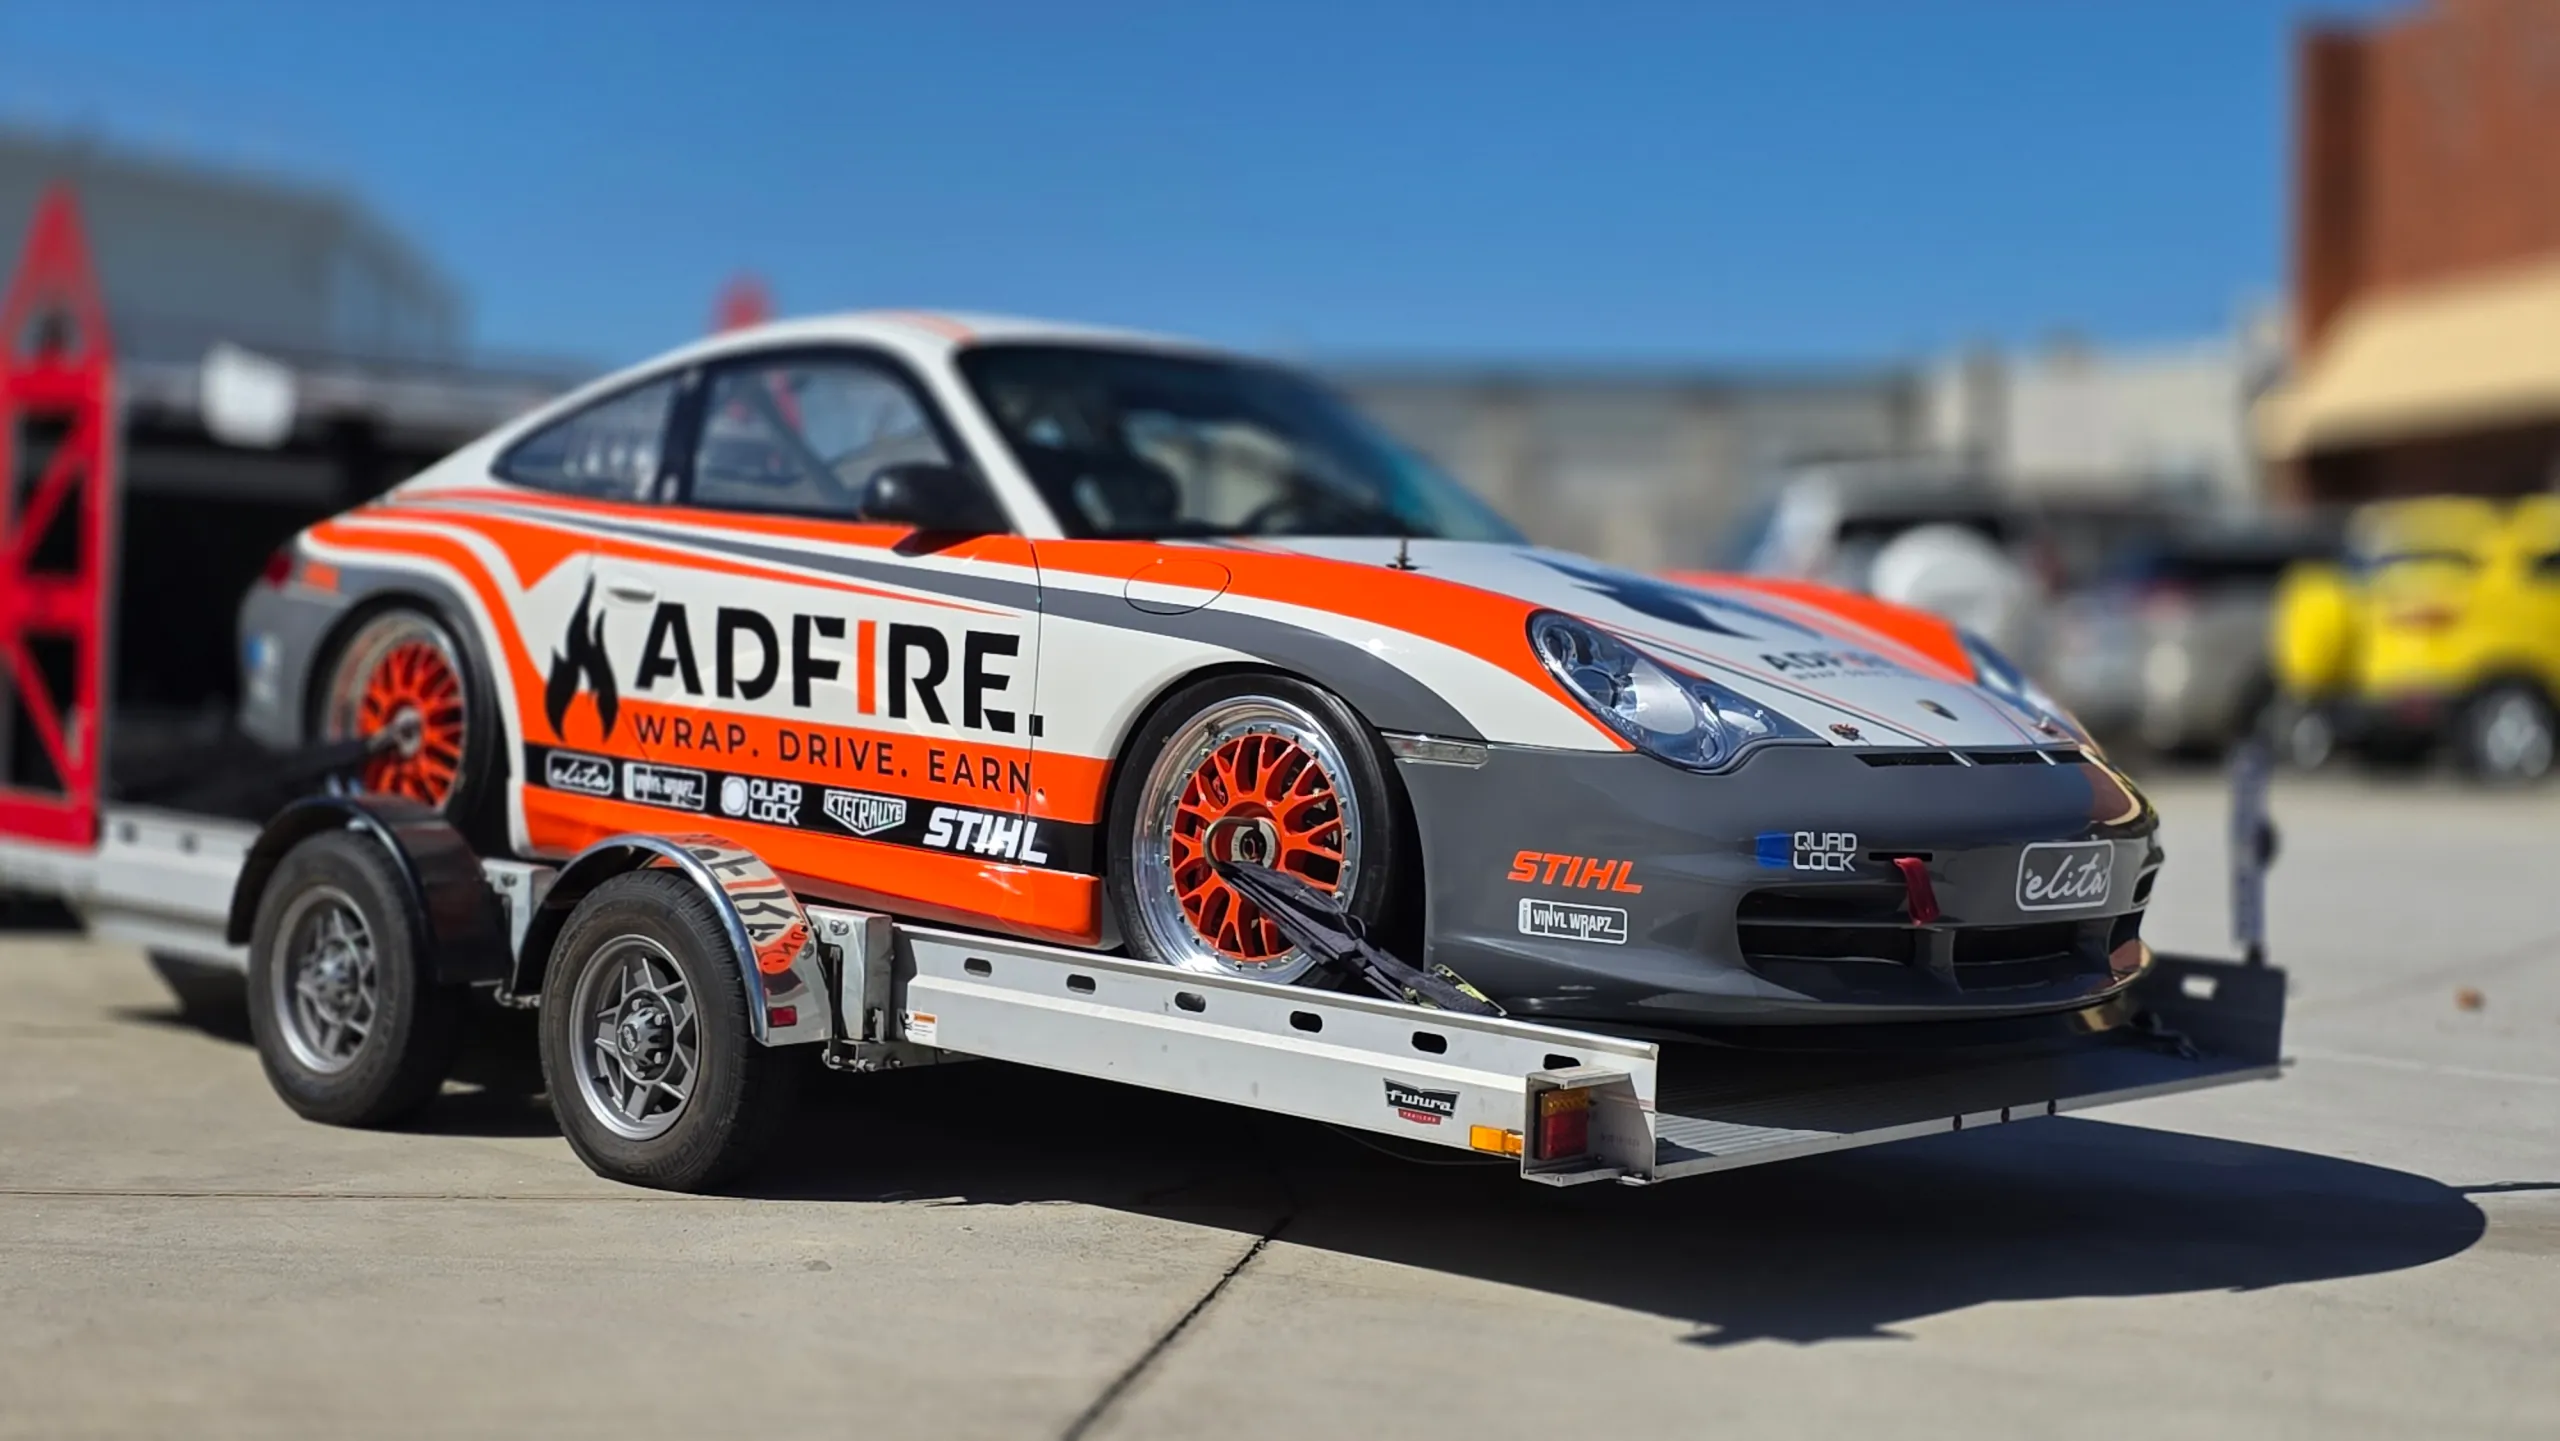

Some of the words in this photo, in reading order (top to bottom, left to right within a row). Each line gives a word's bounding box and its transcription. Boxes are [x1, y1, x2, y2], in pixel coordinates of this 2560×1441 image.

[634, 601, 1043, 737] ADFIRE.
[634, 713, 759, 757] WRAP.
[779, 729, 908, 778] DRIVE.
[928, 749, 1045, 796] EARN.
[749, 778, 802, 805] QUAD
[748, 799, 801, 826] LOCK
[922, 806, 1048, 865] STIHL
[1794, 831, 1858, 852] QUAD
[1507, 850, 1643, 894] STIHL
[1793, 850, 1856, 872] LOCK
[1533, 906, 1568, 932] VINYL
[1569, 913, 1613, 936] WRAPZ
